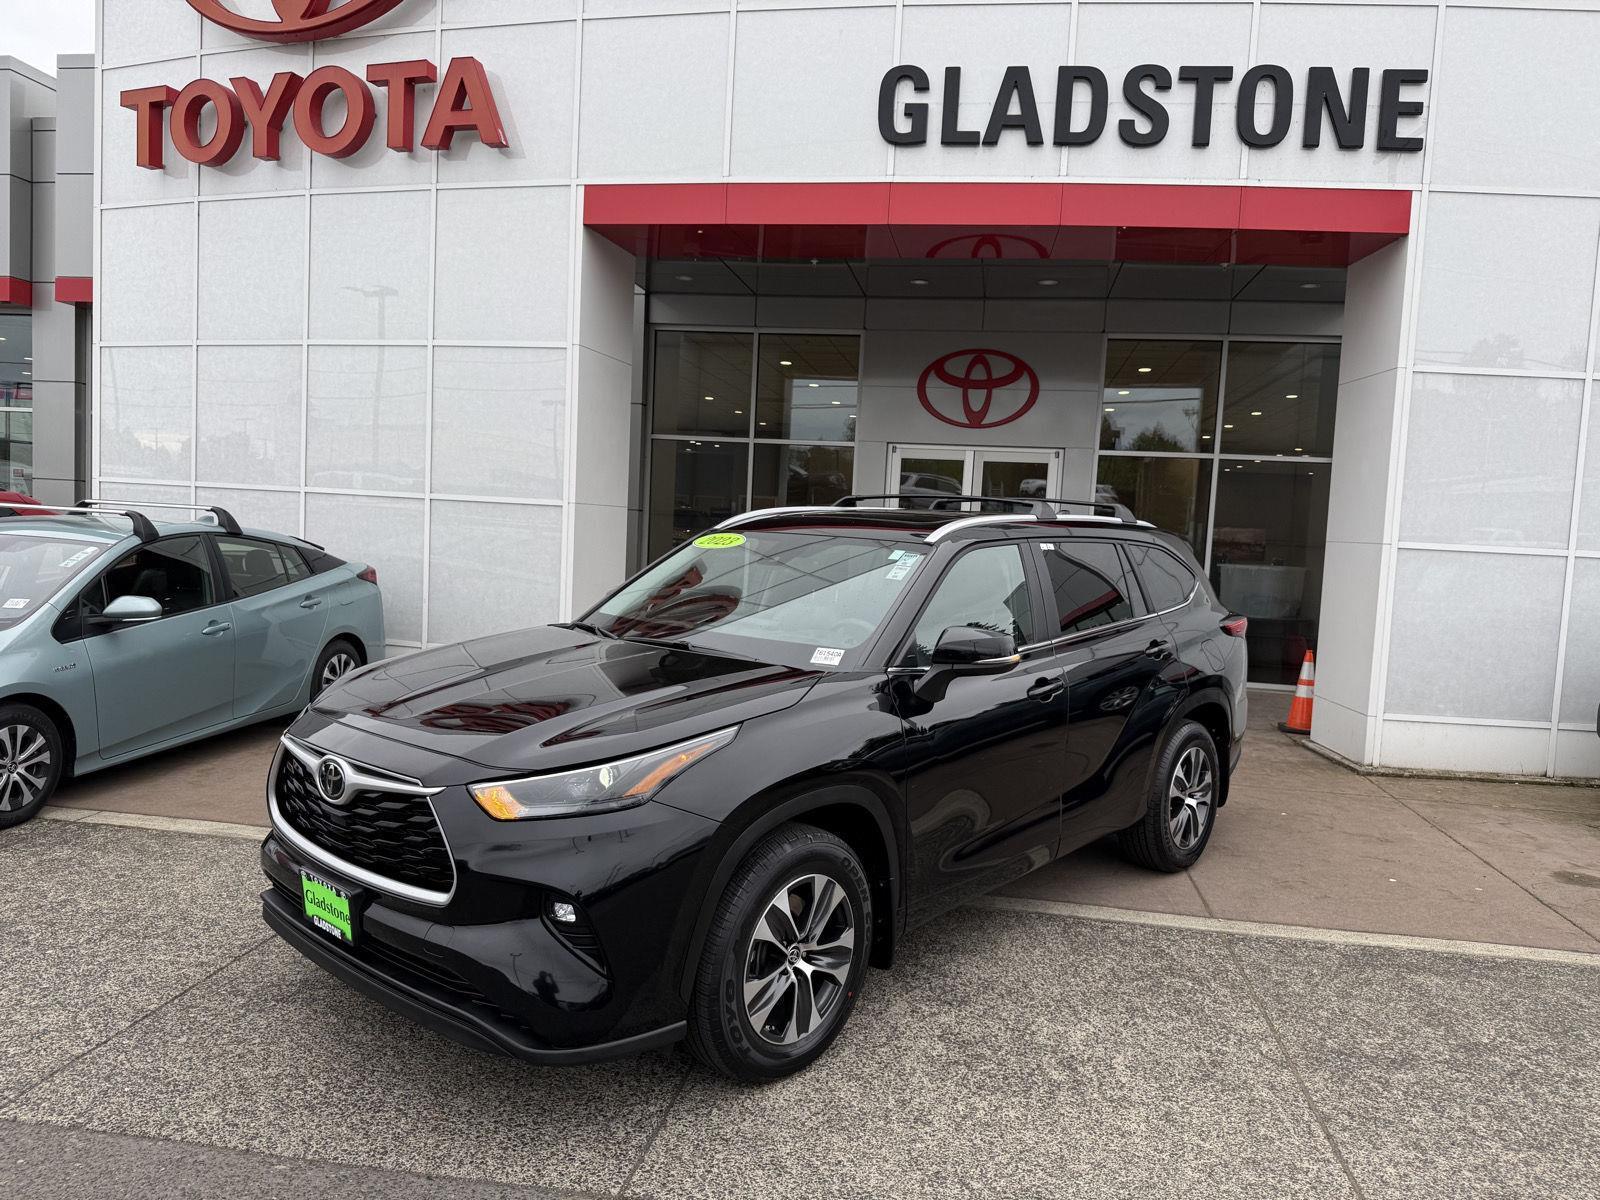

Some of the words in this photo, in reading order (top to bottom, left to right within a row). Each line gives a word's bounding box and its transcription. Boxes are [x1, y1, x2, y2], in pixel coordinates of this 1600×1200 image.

[120, 56, 509, 169] TOYOTA
[877, 64, 1429, 152] GLADSTONE
[697, 536, 741, 546] 2023
[309, 874, 337, 894] TOYOTA
[305, 889, 351, 925] Gladstone
[313, 916, 342, 940] GLADSTONE
